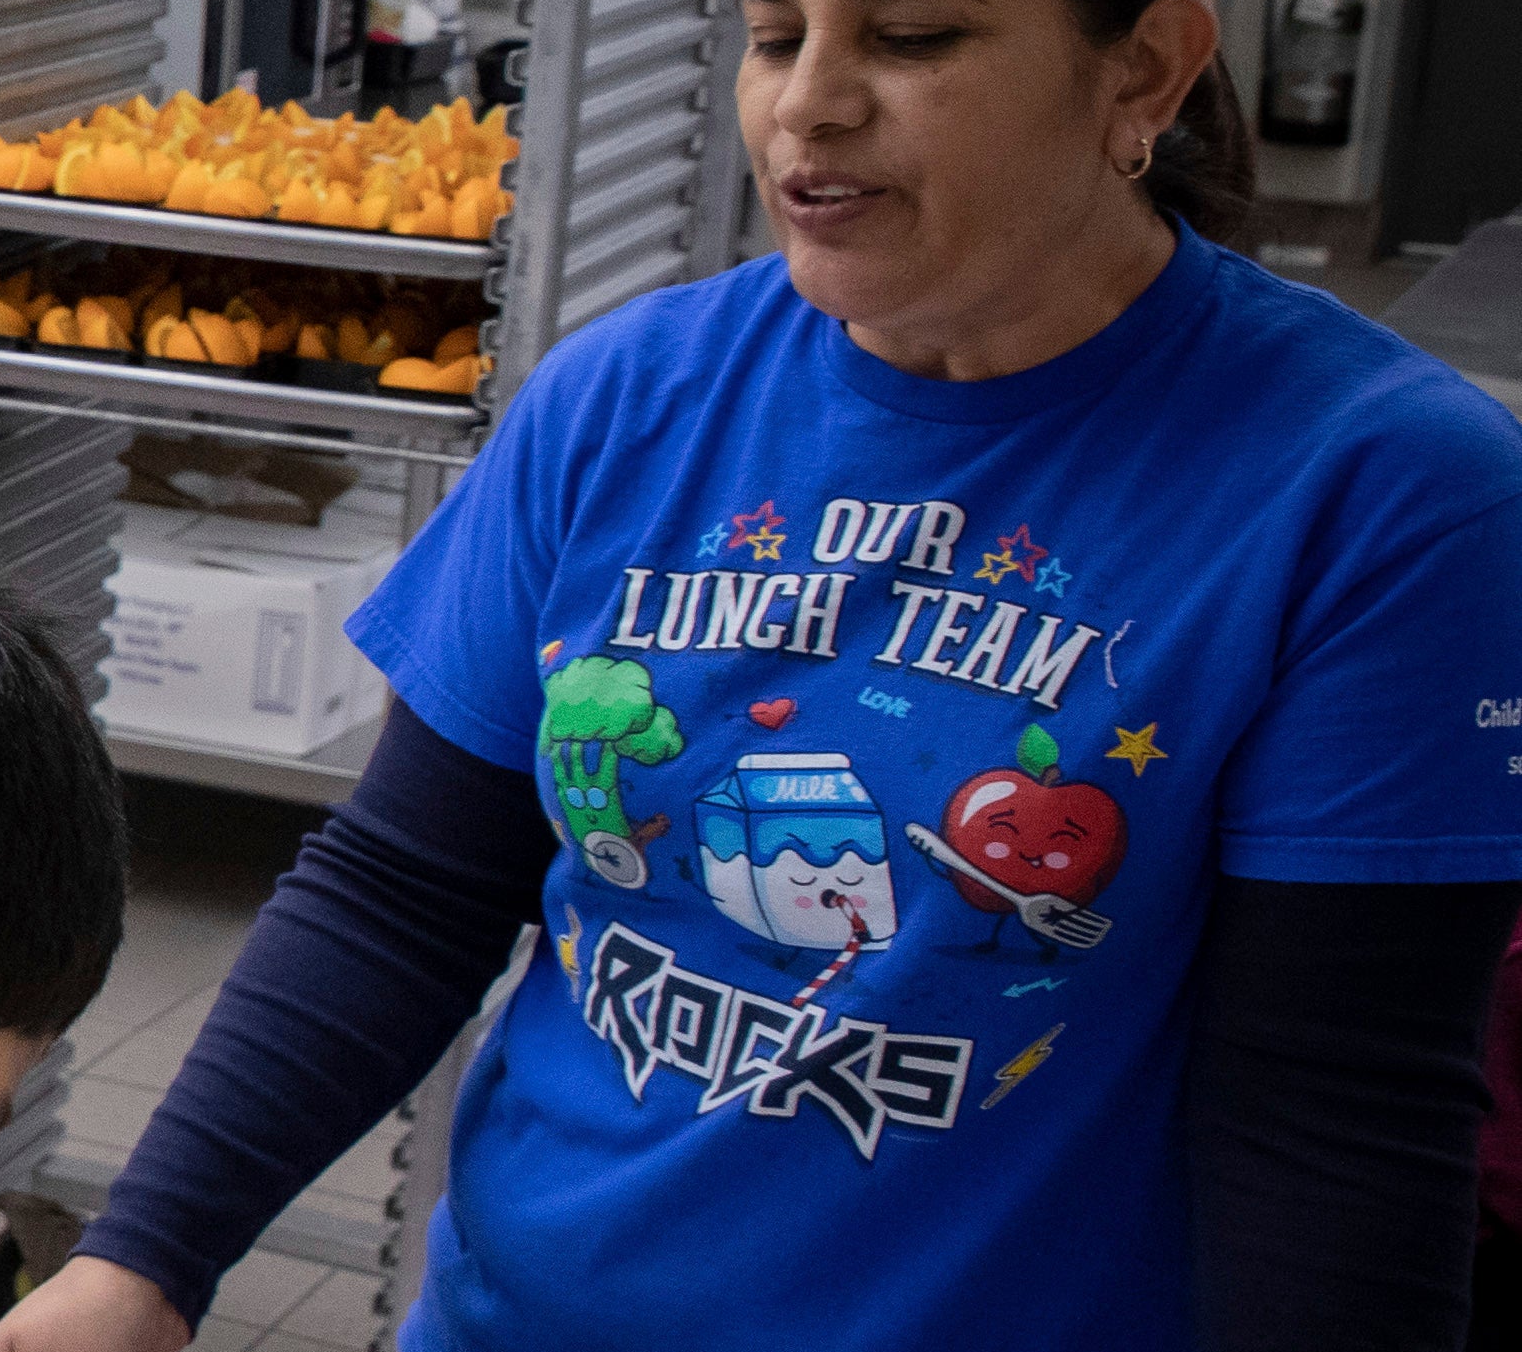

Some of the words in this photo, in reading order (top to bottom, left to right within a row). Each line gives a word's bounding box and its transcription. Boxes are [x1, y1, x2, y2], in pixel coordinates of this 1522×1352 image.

[812, 496, 967, 576] OUR
[608, 567, 857, 659] LUNCH
[874, 579, 1102, 711] TEAM
[857, 685, 913, 719] LOVE
[765, 774, 840, 803] Milk
[582, 920, 974, 1162] ROCKS
